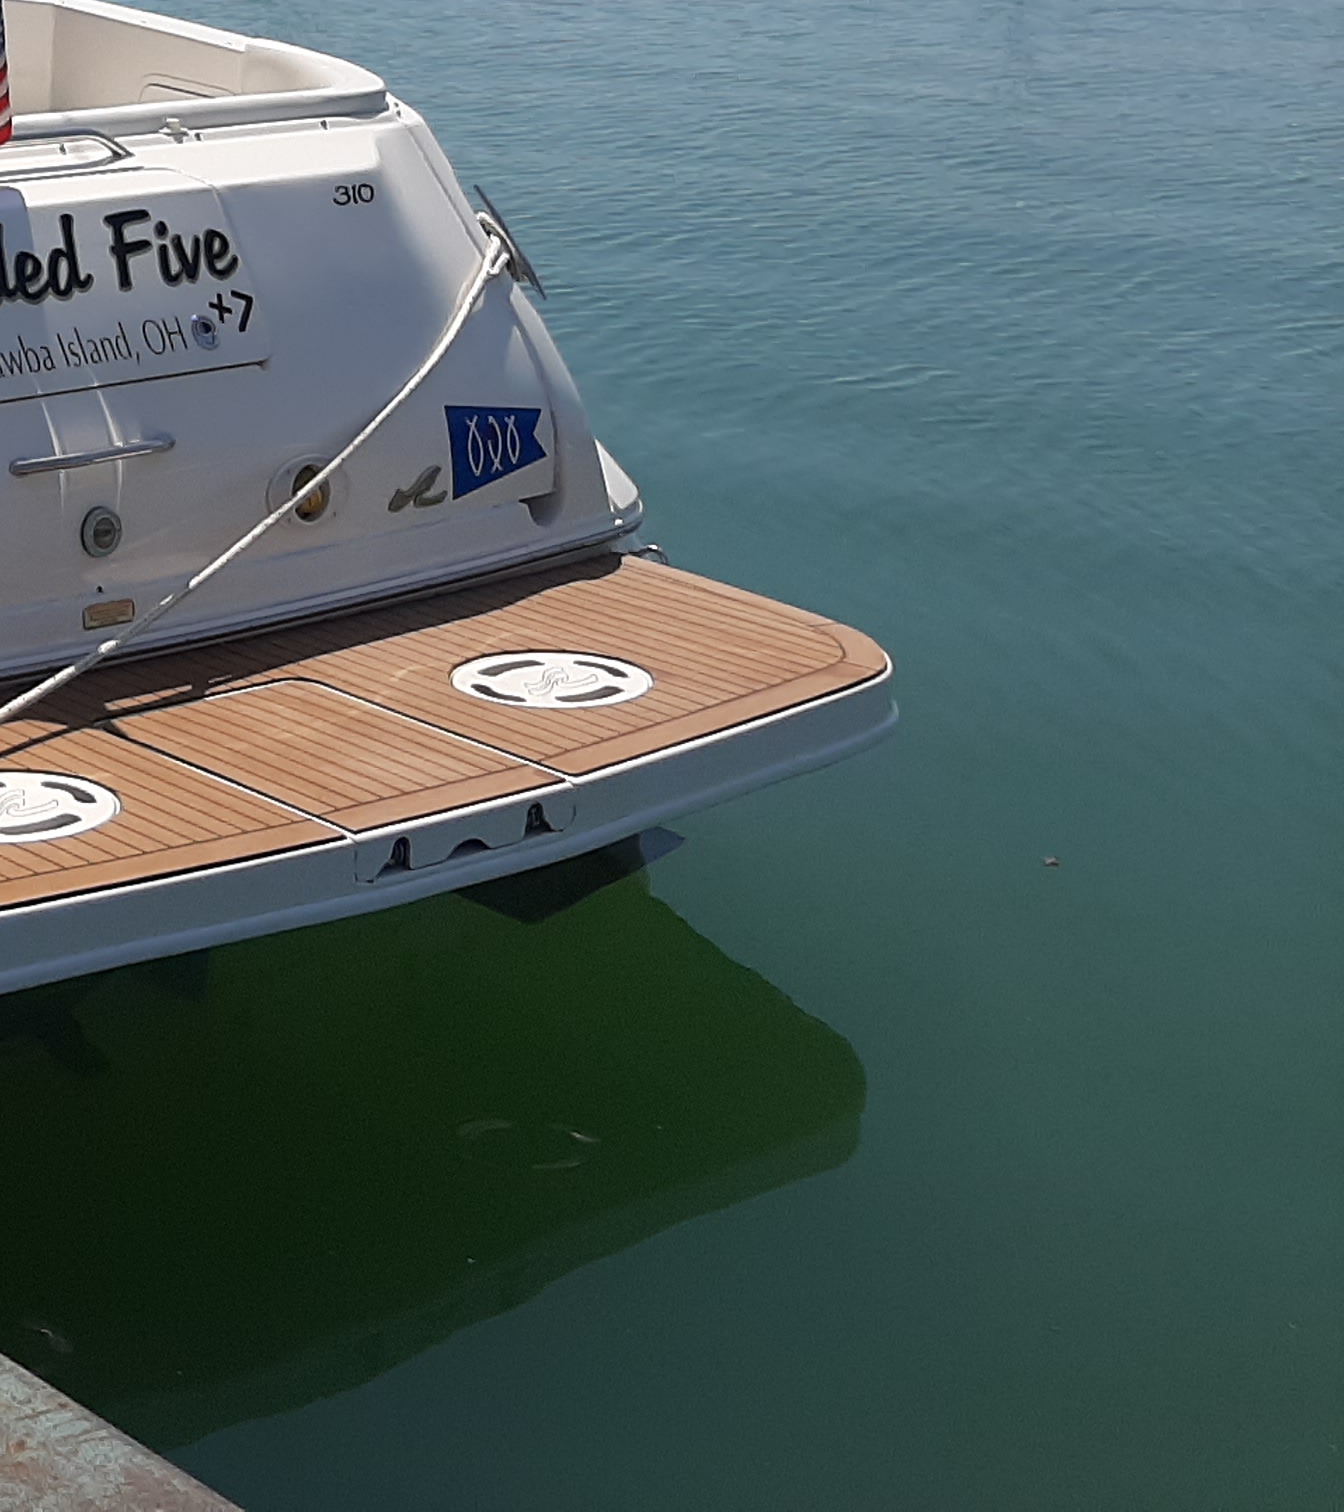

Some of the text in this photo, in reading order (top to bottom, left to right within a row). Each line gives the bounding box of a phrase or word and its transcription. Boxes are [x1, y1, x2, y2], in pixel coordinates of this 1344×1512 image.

[332, 182, 375, 206] 310
[103, 208, 240, 291] Five
[56, 322, 142, 367] Island,
[141, 316, 190, 356] OH
